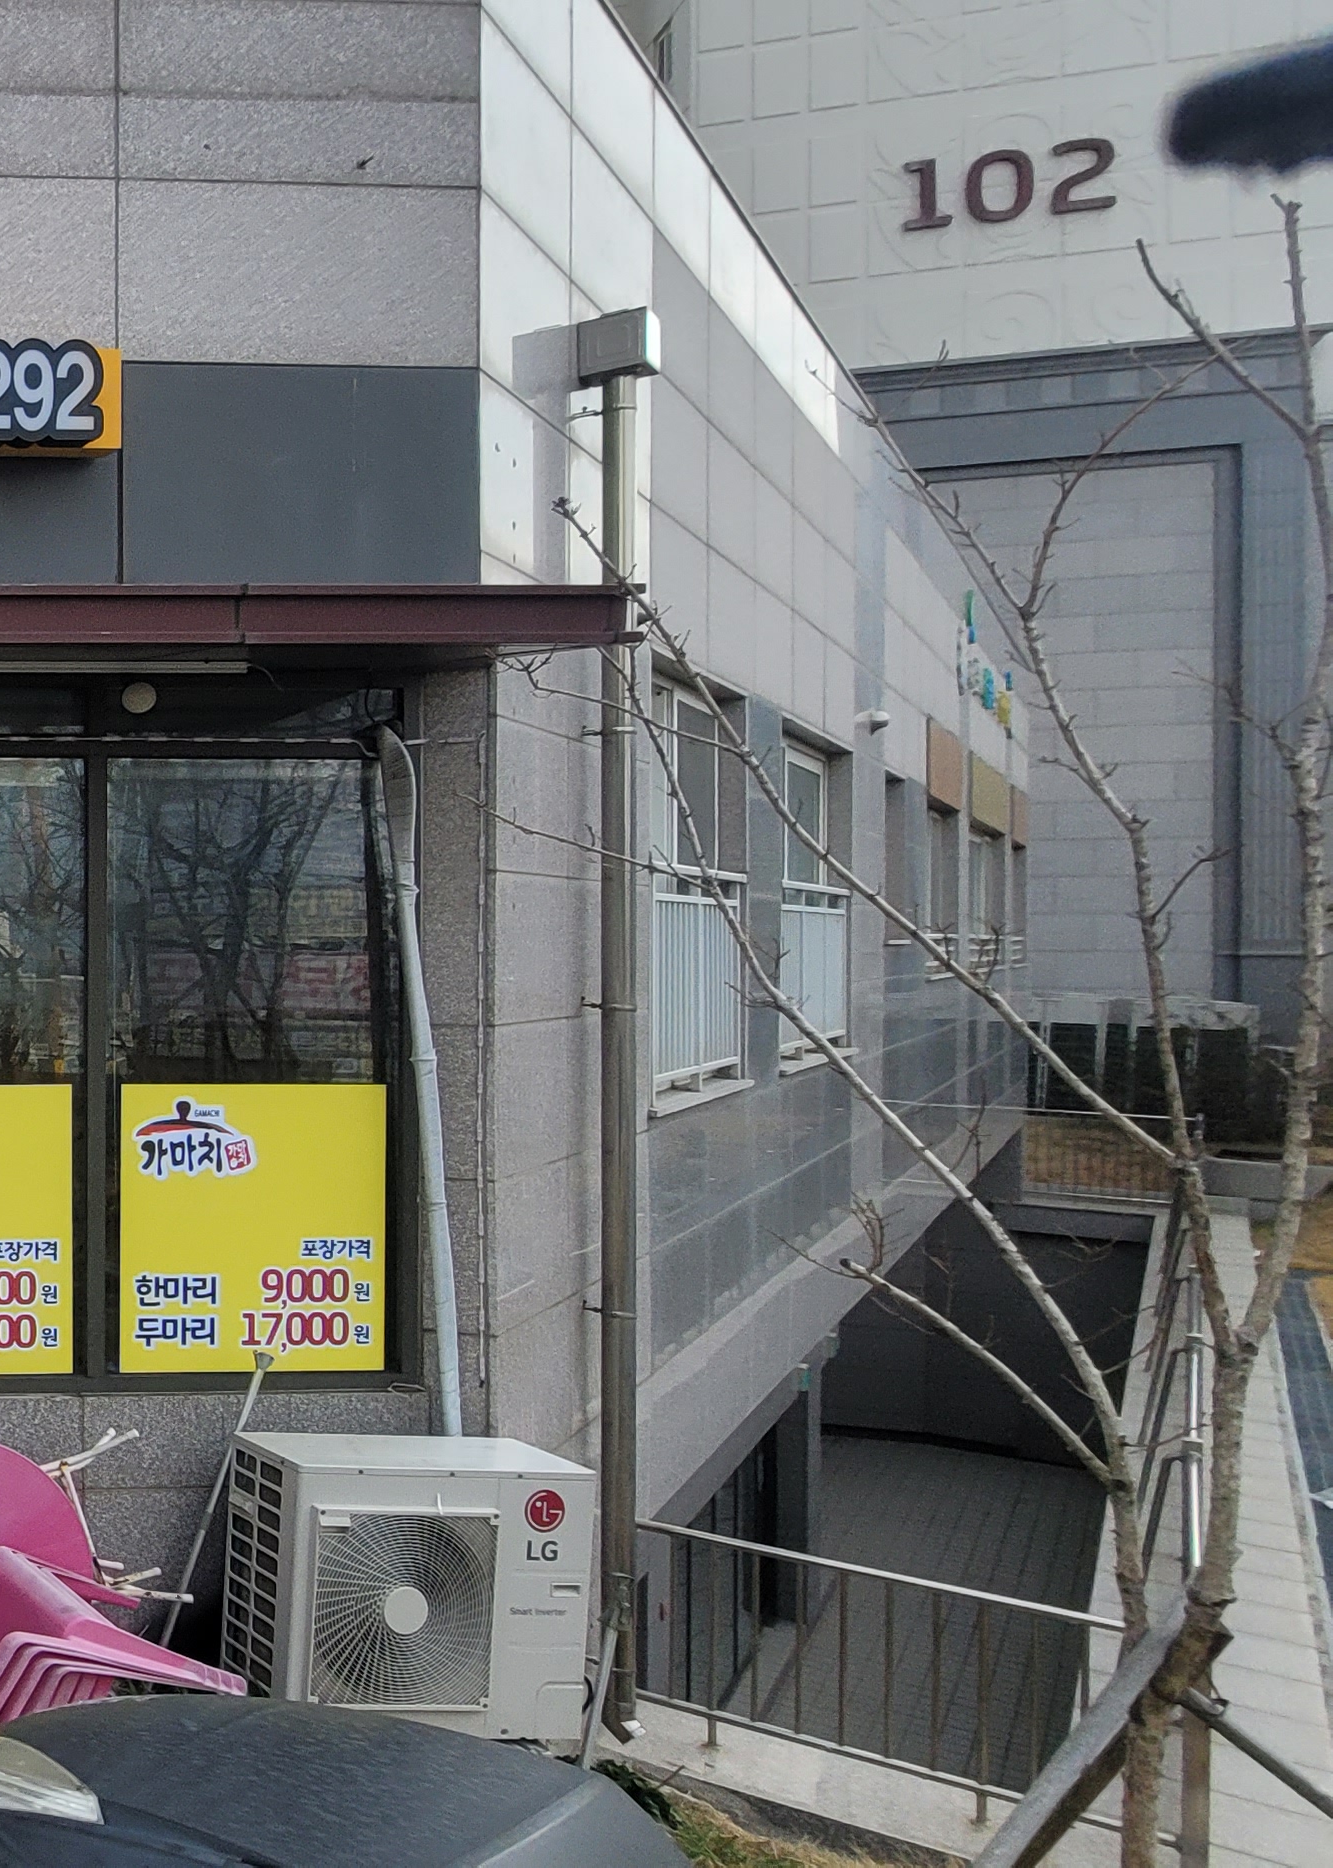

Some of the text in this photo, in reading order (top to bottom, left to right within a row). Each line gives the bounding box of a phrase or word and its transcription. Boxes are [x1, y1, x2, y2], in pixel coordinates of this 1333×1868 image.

[902, 137, 1117, 232] 102
[141, 1132, 222, 1176] 가마치
[302, 1239, 371, 1259] 포장가격
[41, 1285, 58, 1304] 원
[135, 1269, 370, 1309] 한마리 9,000 원
[41, 1328, 58, 1347] 원
[135, 1312, 370, 1353] 두마리 17,000 원
[526, 1540, 559, 1562] LG
